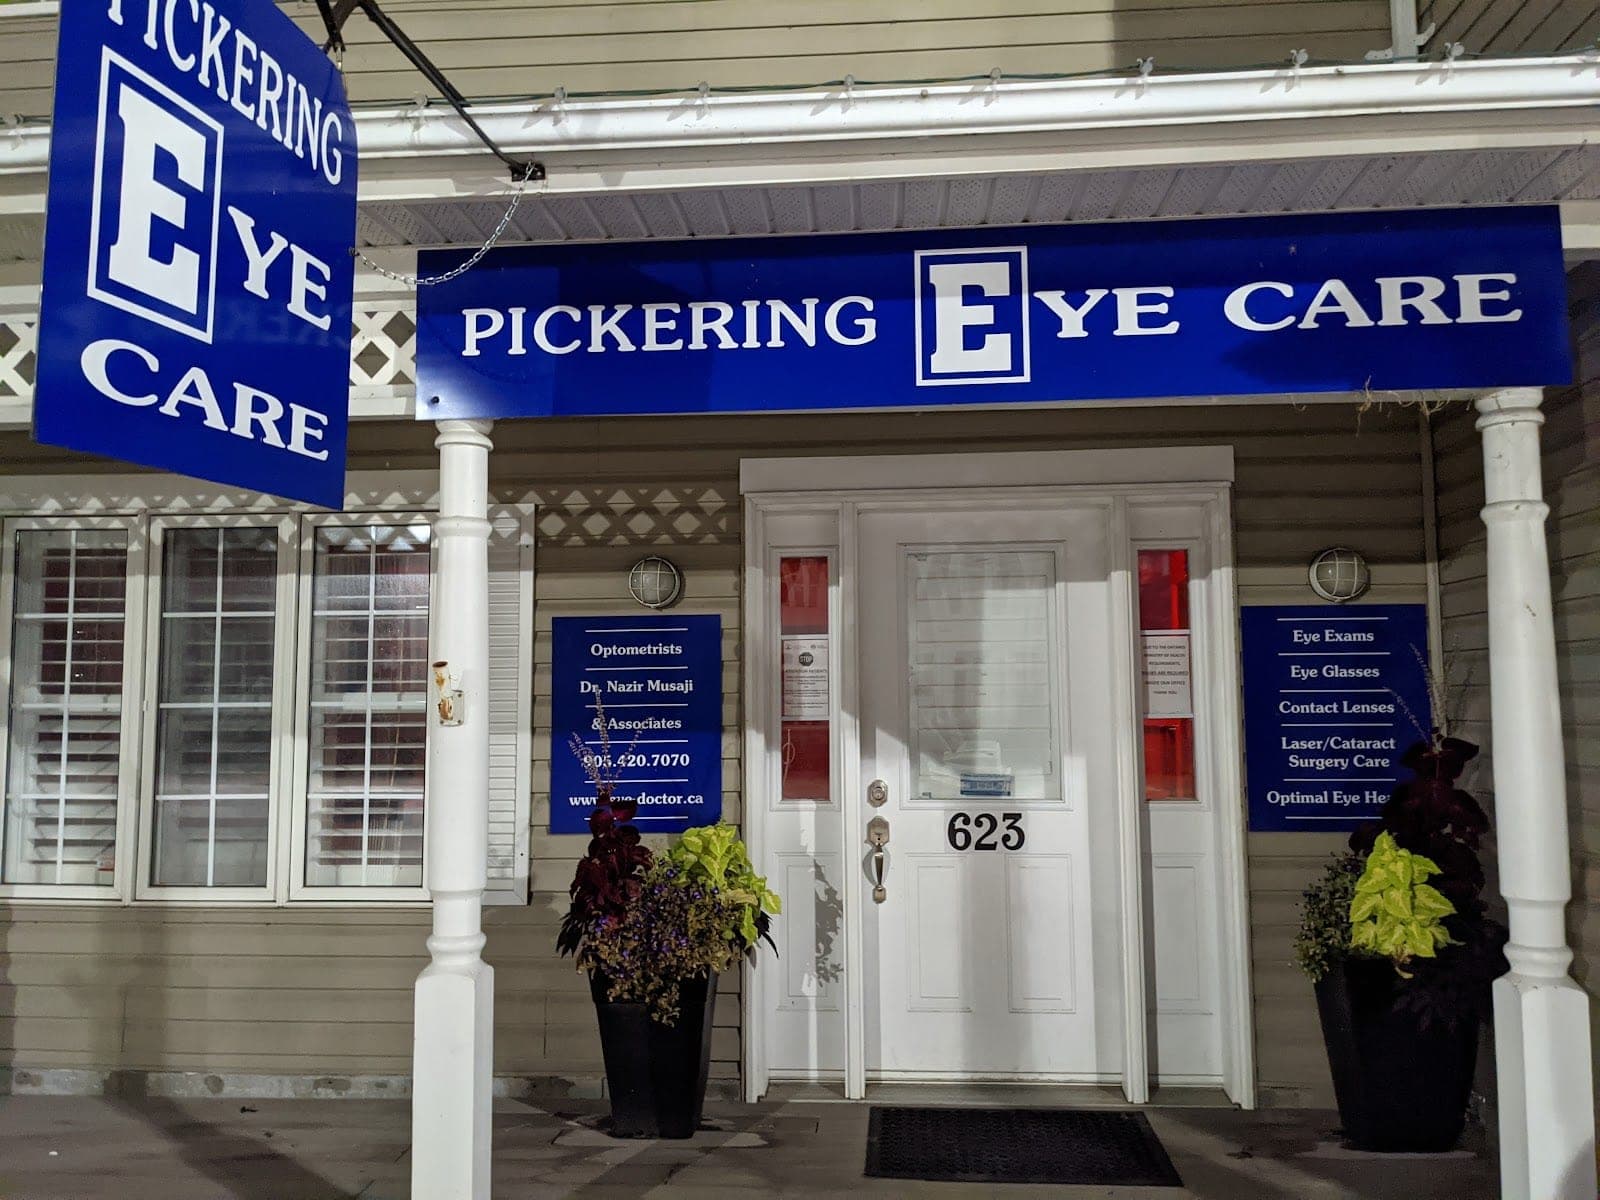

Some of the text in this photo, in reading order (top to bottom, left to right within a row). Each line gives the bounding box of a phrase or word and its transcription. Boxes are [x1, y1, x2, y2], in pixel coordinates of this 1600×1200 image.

[461, 296, 877, 356] PICKERING
[1223, 273, 1523, 332] CARE
[80, 338, 329, 461] CARE
[1293, 629, 1375, 644] Eye Exams
[590, 643, 682, 658] Optometrists
[1291, 665, 1380, 680] Eye Glasses
[580, 679, 693, 694] Dr. Nazir Musaji
[1279, 700, 1395, 714] Contact Lenses
[591, 717, 682, 730] & Associates
[1281, 737, 1396, 751] Laser/Cataract
[1288, 754, 1390, 769] Surgery Care
[1266, 791, 1328, 806] Optimal
[1333, 791, 1360, 806] Eye
[947, 812, 1026, 851] 623
